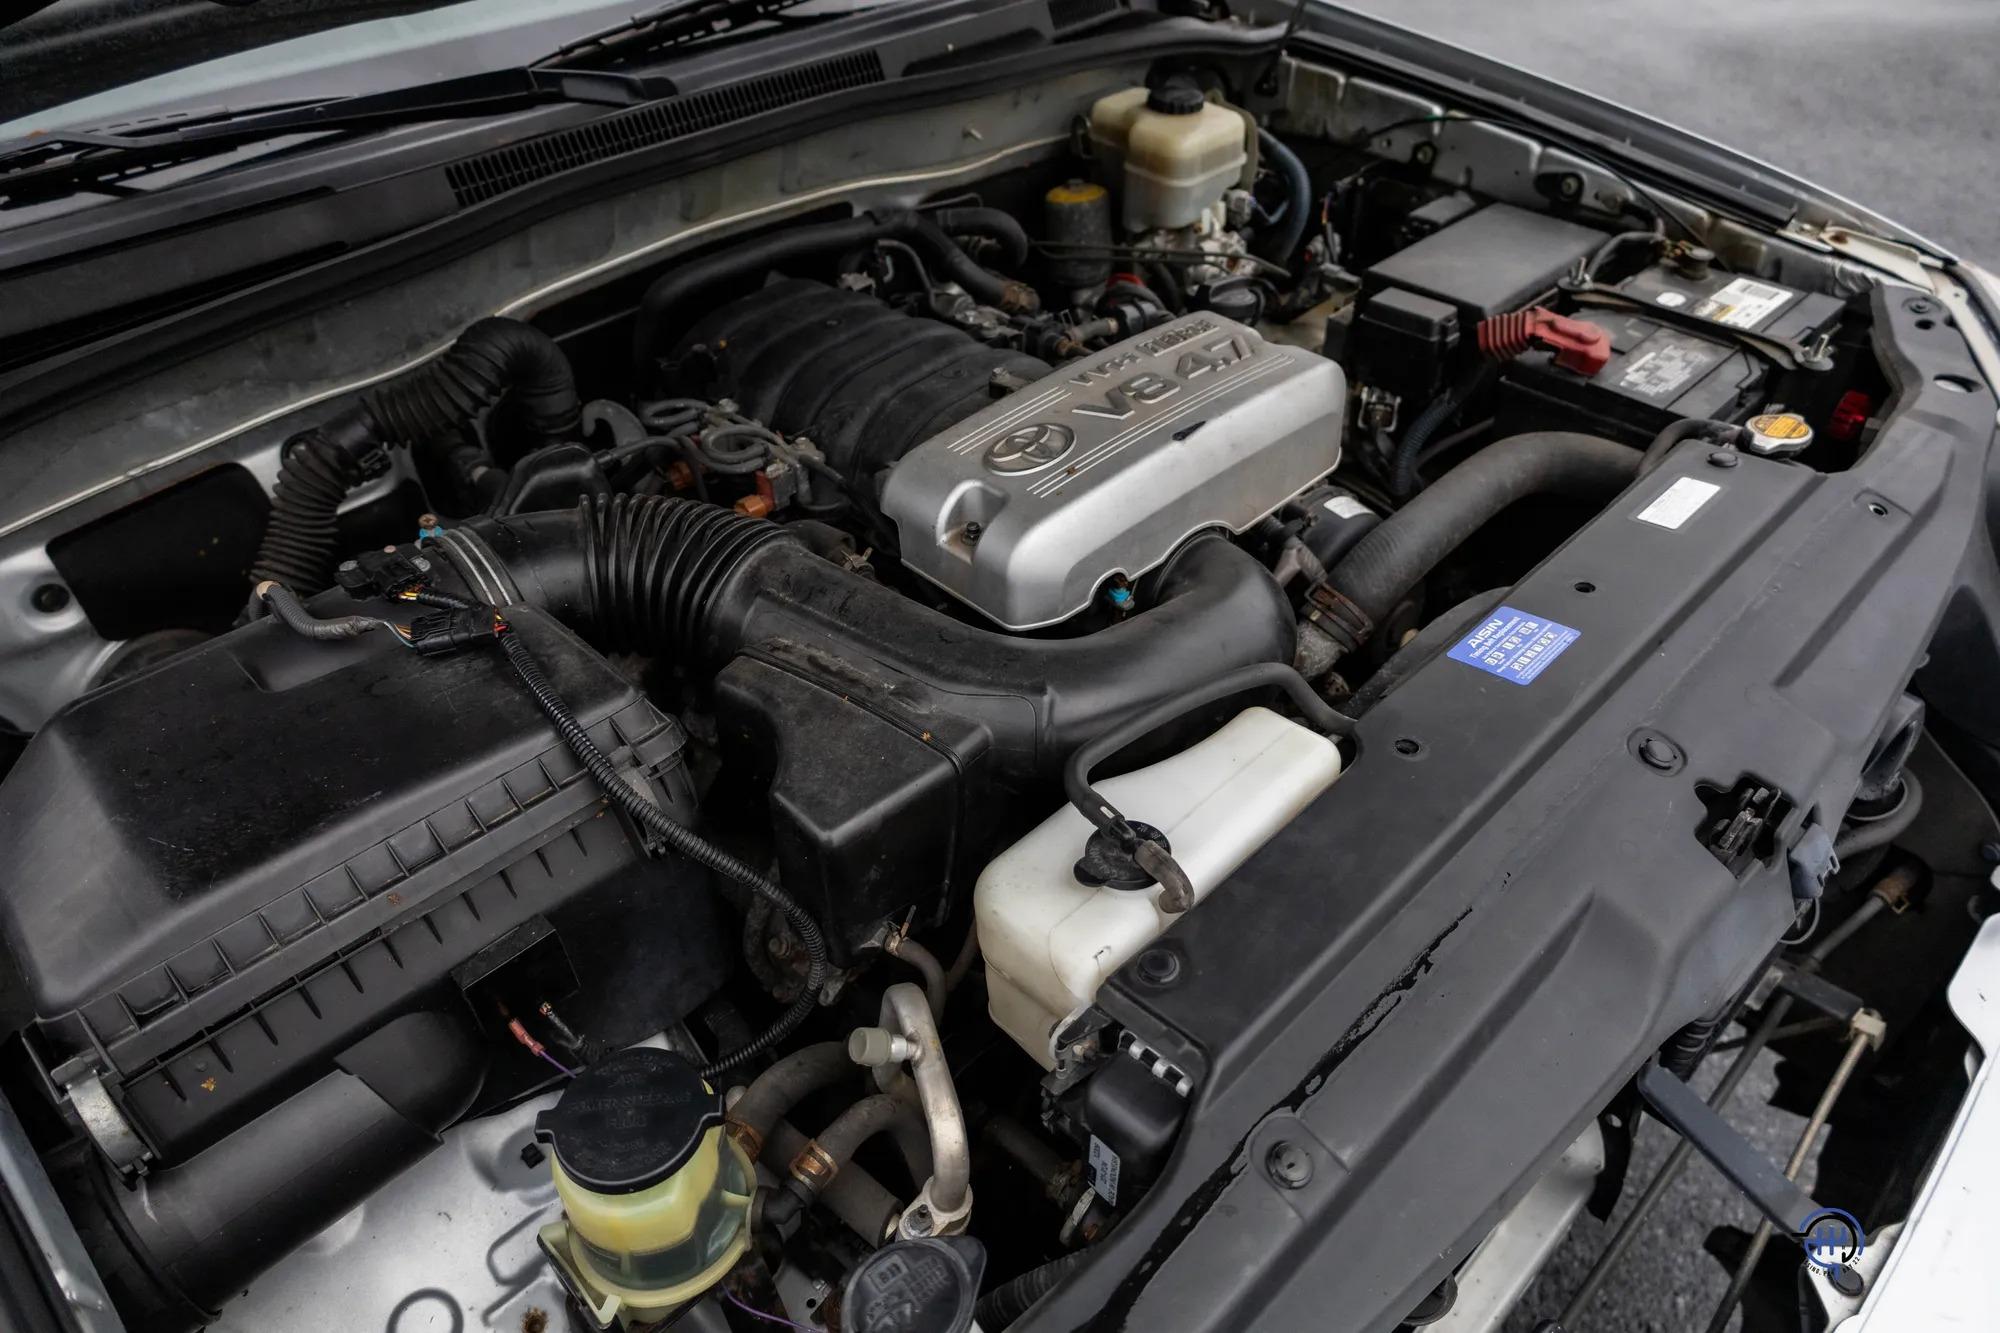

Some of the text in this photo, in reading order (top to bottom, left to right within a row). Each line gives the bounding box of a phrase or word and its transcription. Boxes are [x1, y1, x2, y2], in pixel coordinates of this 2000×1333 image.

[1072, 334, 1252, 420] V8 4.7
[1467, 618, 1504, 649] AISIN
